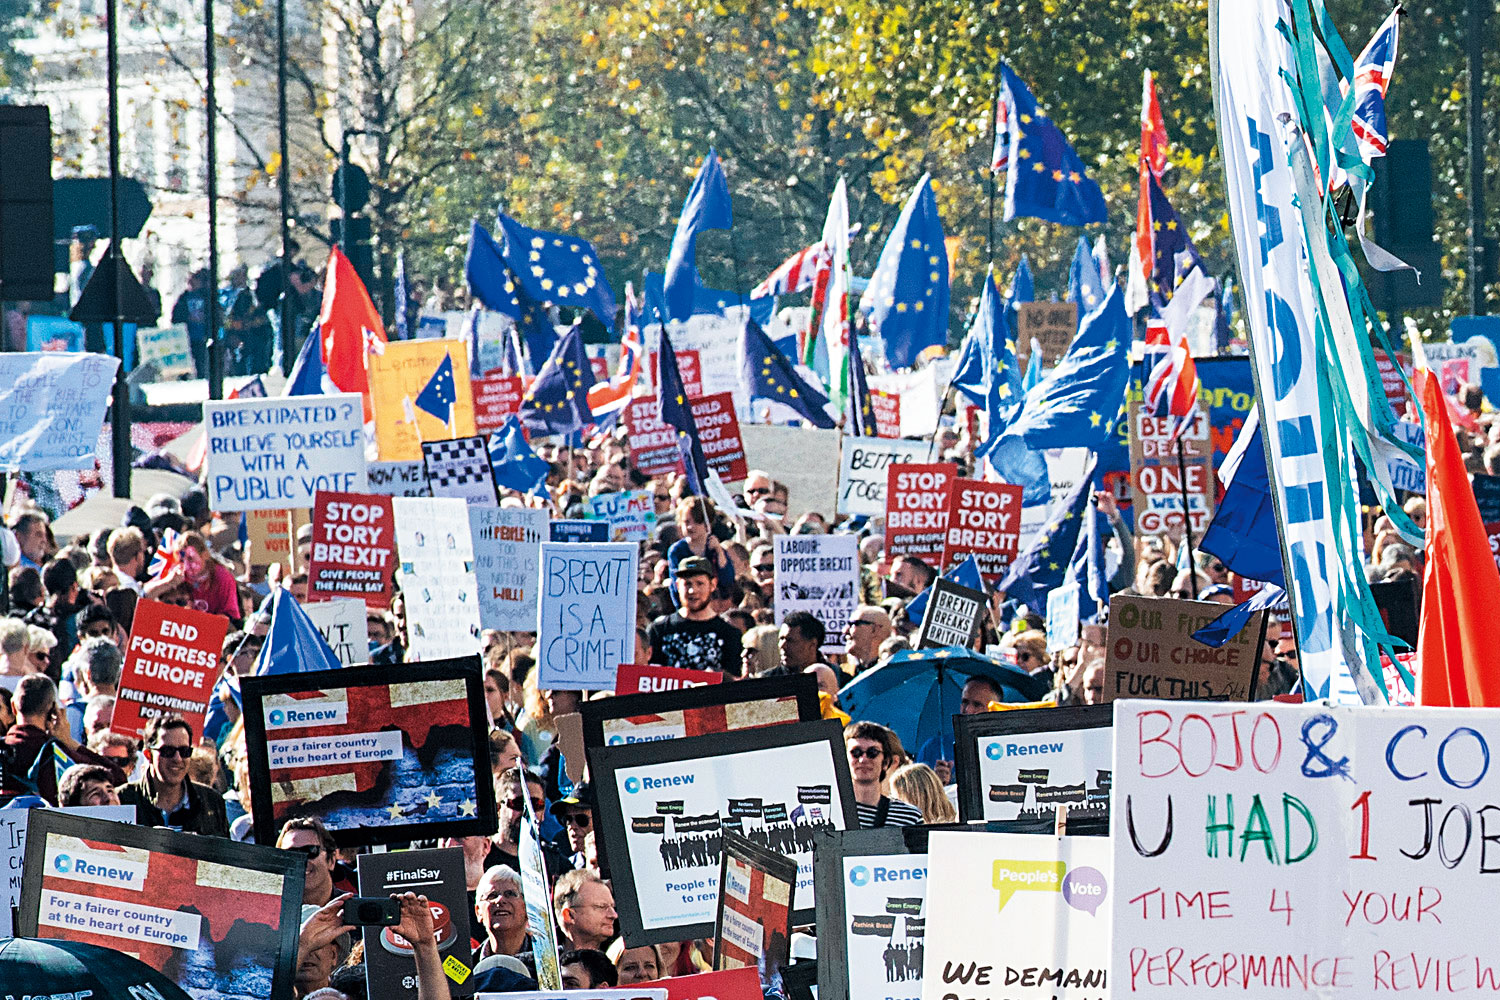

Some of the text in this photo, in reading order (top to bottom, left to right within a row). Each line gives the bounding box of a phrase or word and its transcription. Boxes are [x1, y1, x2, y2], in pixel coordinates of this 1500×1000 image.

[211, 430, 361, 454] RELIEVE YOURSELF
[242, 454, 309, 471] WITH A
[216, 475, 294, 502] PUBLIC
[897, 473, 946, 490] STOP
[326, 503, 384, 523] STOP
[896, 493, 946, 509] TORY
[888, 513, 949, 528] BREXIT
[323, 524, 383, 544] TORY
[312, 543, 391, 567] BREXIT
[781, 541, 820, 554] LABOUR:
[548, 555, 631, 598] BREXIT
[781, 557, 852, 572] OPPOSE BREXIT
[939, 592, 977, 617] BREXIT
[159, 620, 199, 642] END
[560, 605, 607, 635] IS A
[934, 610, 970, 632] BREAKS
[929, 626, 967, 647] BRITAIN
[130, 634, 217, 669] FORTRESS
[546, 635, 625, 674] CRIME!
[1114, 638, 1240, 666] OUR CHOICE
[135, 660, 204, 688] EUROPE
[1115, 671, 1212, 698] FUCK THIS
[121, 690, 206, 714] FREE MOVEMENT
[286, 707, 338, 723] Renew
[270, 743, 289, 755] For
[301, 739, 331, 751] fairer
[334, 738, 377, 754] country
[272, 746, 394, 765] at the heart of Europe
[1007, 742, 1064, 757] Renew
[1136, 709, 1491, 789] BOJO & CO
[1063, 789, 1084, 797] economy
[1126, 794, 1174, 858] U
[1206, 792, 1319, 866] HAD
[1349, 791, 1379, 862] 1
[386, 869, 440, 881] #FinalSay
[1000, 868, 1101, 895] People's Vote
[1129, 886, 1443, 926] TIME 4 YOUR
[943, 961, 989, 986] WE
[1129, 947, 1354, 992] PERFORMANCE
